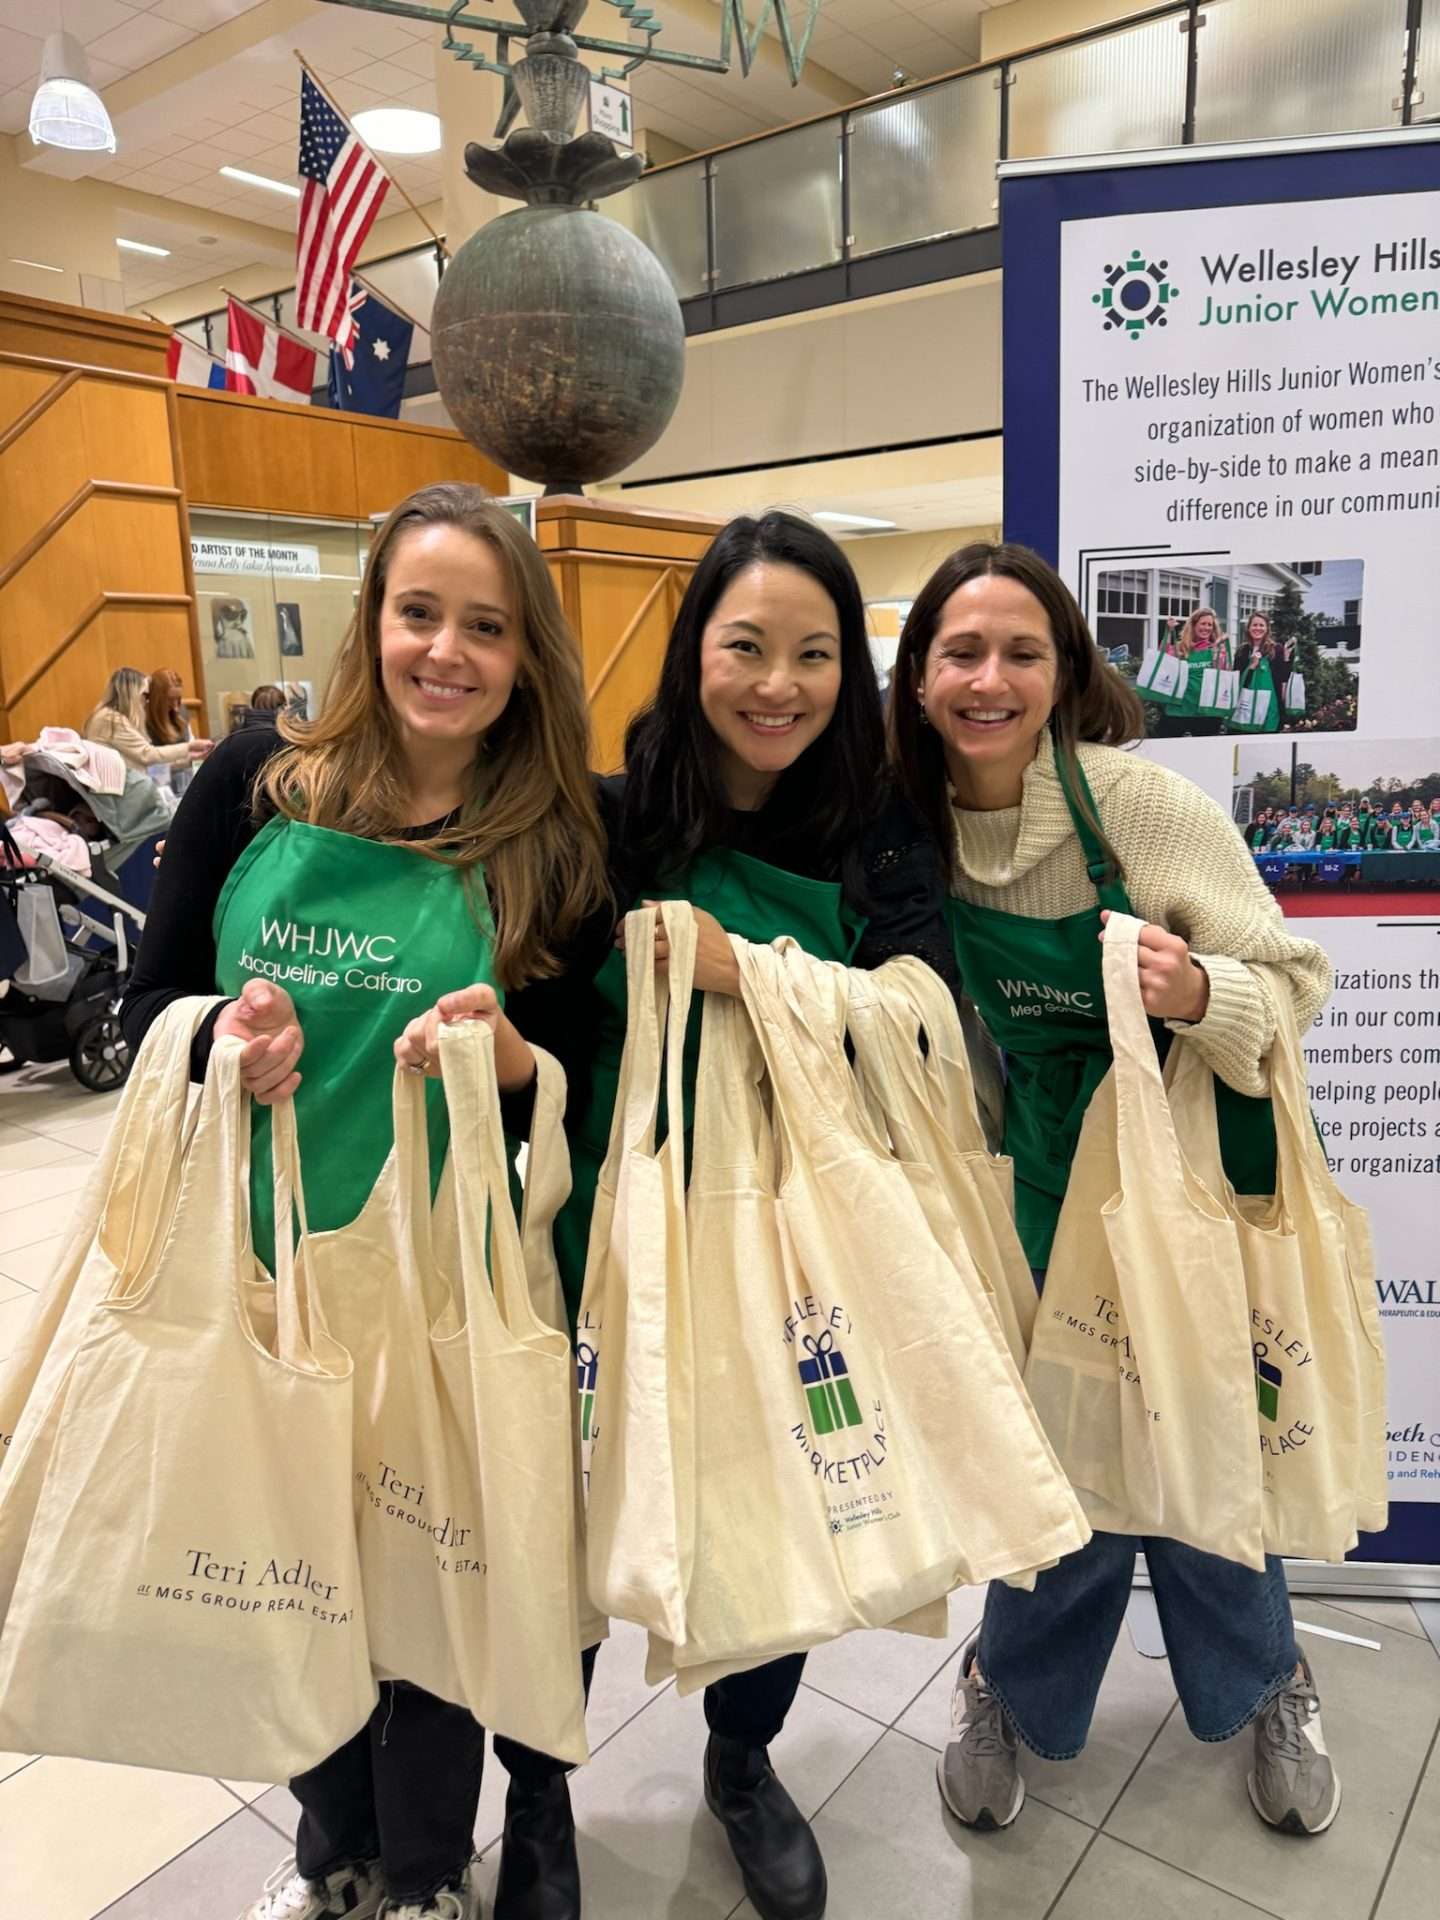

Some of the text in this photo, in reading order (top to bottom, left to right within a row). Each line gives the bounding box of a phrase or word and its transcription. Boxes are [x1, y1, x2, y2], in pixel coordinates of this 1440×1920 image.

[1200, 237, 1440, 286] Wellesley Hills
[1198, 286, 1440, 326] Junior Women
[1083, 379, 1119, 402] The
[1125, 372, 1220, 400] Wellesley
[1227, 368, 1272, 394] Hills
[1278, 365, 1342, 392] Junior
[1148, 401, 1435, 444] organization of women who
[1134, 448, 1439, 484] side-by-side to make a mean
[1166, 485, 1440, 523] difference in our communi
[201, 544, 232, 556] ARTIST
[235, 546, 246, 557] OF
[248, 547, 266, 559] THE
[267, 549, 298, 561] MONTH
[261, 915, 396, 962] WHJWC
[238, 948, 423, 993] Jacqueline Cafaro
[1334, 968, 1440, 990] izations th
[997, 979, 1094, 1009] WHJWC
[1010, 1004, 1042, 1018] Meg
[1312, 1006, 1440, 1028] e in our com
[1303, 1043, 1440, 1064] members com
[1384, 1080, 1440, 1105] peopl
[1349, 1116, 1427, 1141] projects
[1327, 1158, 1344, 1173] er
[1066, 1316, 1096, 1337] MGS
[1251, 1308, 1312, 1367] ESLEY
[1259, 1420, 1315, 1456] PLACE
[1388, 1450, 1440, 1463] IDEN
[378, 1461, 425, 1506] Teri
[1397, 1468, 1417, 1478] and
[827, 1491, 893, 1513] PRESENTED BY
[186, 1549, 339, 1601] Teri Adler
[155, 1586, 195, 1601] MGS
[201, 1592, 262, 1613] GROUP
[267, 1598, 305, 1613] REAL
